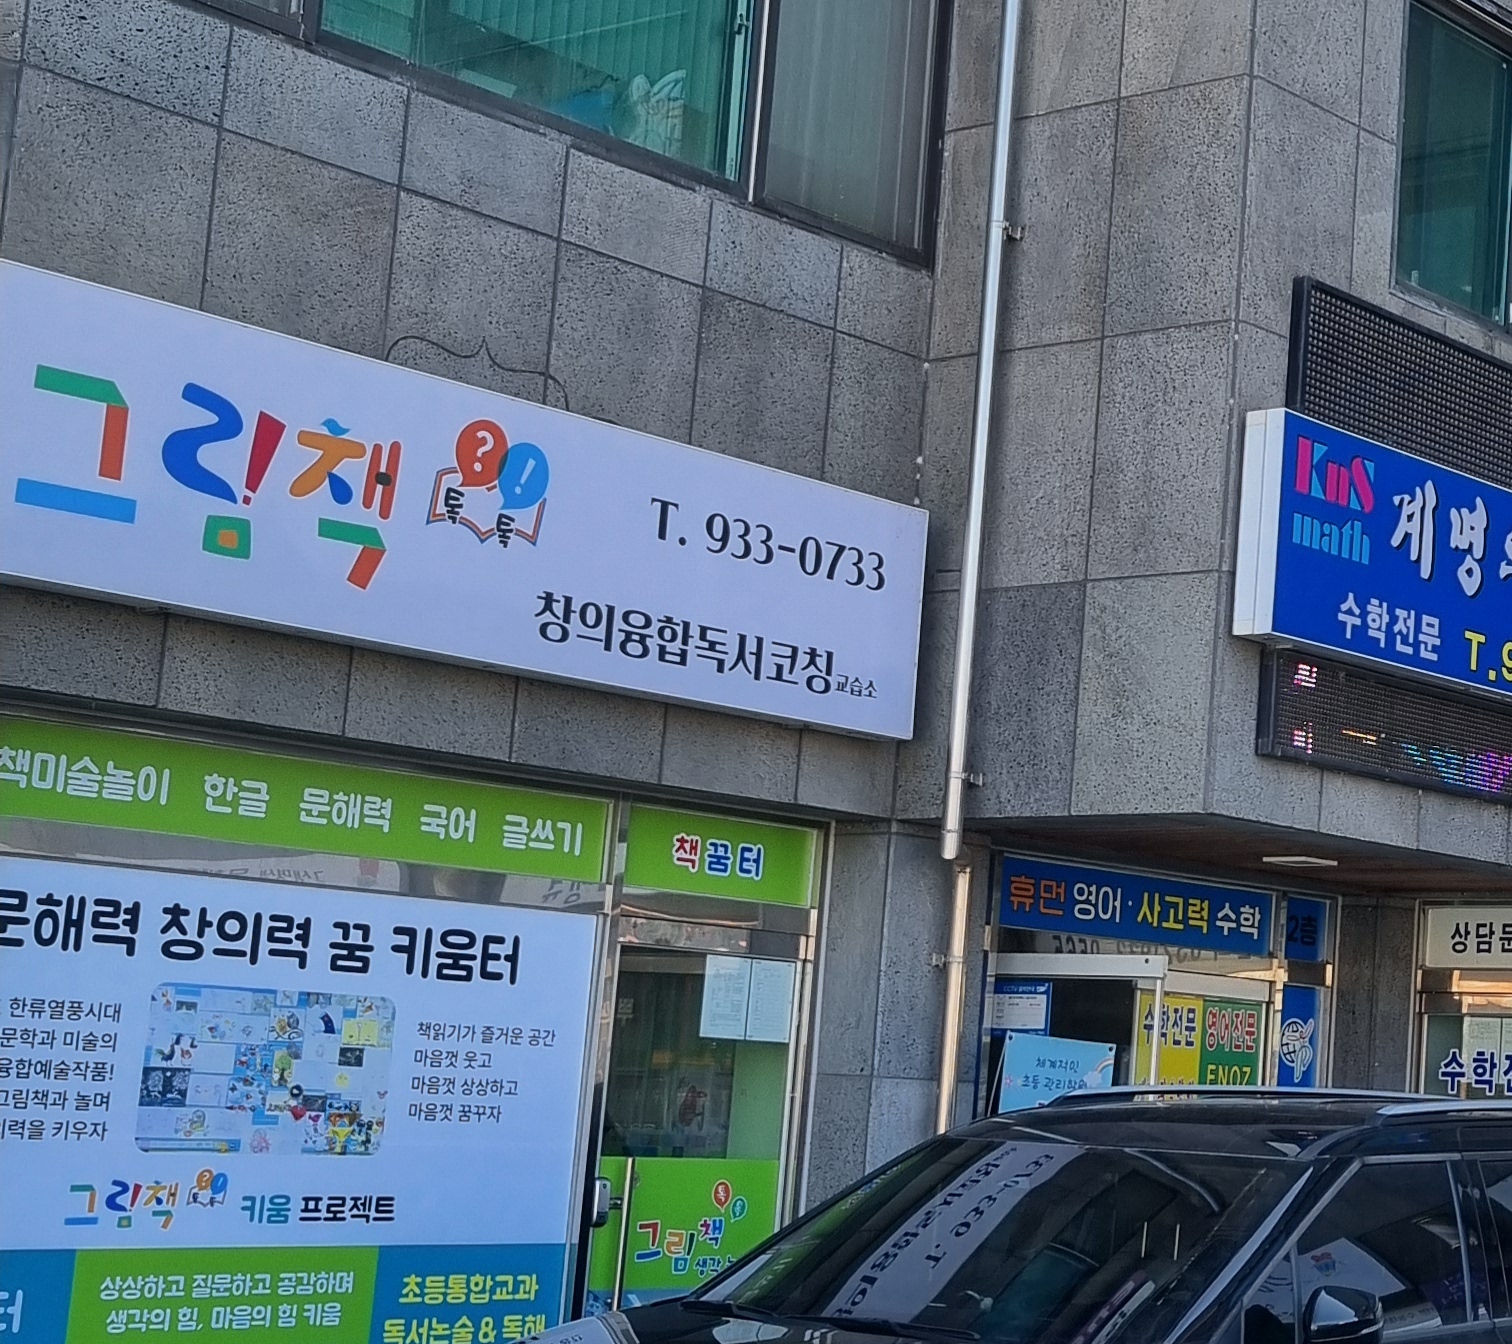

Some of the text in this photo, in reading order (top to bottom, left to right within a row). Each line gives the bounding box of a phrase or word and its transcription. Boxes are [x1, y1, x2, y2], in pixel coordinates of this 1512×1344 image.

[15, 362, 402, 591] 그림책
[650, 497, 887, 592] T. 933-0733
[1292, 511, 1371, 566] math
[533, 590, 836, 695] 창의융합독서코칭
[1337, 591, 1442, 662] 수학전문
[0, 745, 583, 857] 책미술놀이 한글 문해력 국어 글쓰기
[1009, 874, 1066, 917] 휴먼
[1137, 891, 1210, 935] 사고력
[1215, 901, 1261, 940] 수학
[160, 902, 312, 971] 창의력
[328, 920, 375, 975] 꿈
[390, 925, 521, 986] 키움터
[9, 996, 122, 1024] 한류열풍시대
[0, 1027, 118, 1054] 문학과 미술의
[416, 1021, 556, 1048] 책읽기가 즐거운 공간
[1206, 1007, 1258, 1052] 영어전문
[414, 1048, 492, 1070] 마음껏 웃고
[74, 1090, 111, 1113] 놀며
[411, 1075, 519, 1098] 마음껏 상상하고
[52, 1119, 109, 1142] 키우자
[408, 1102, 503, 1124] 마음껏 꿈꾸자
[64, 1179, 180, 1231] 그림책
[241, 1194, 292, 1225] 키움
[298, 1196, 396, 1225] 프로젝트
[635, 1217, 725, 1275] 그림책
[100, 1271, 354, 1301] 상상하고 질문하고 공감하며
[399, 1273, 539, 1305] 초등통합교과
[106, 1308, 171, 1334] 생각의
[210, 1305, 272, 1330] 마음의
[277, 1303, 298, 1328] 힘
[303, 1302, 342, 1327] 키움
